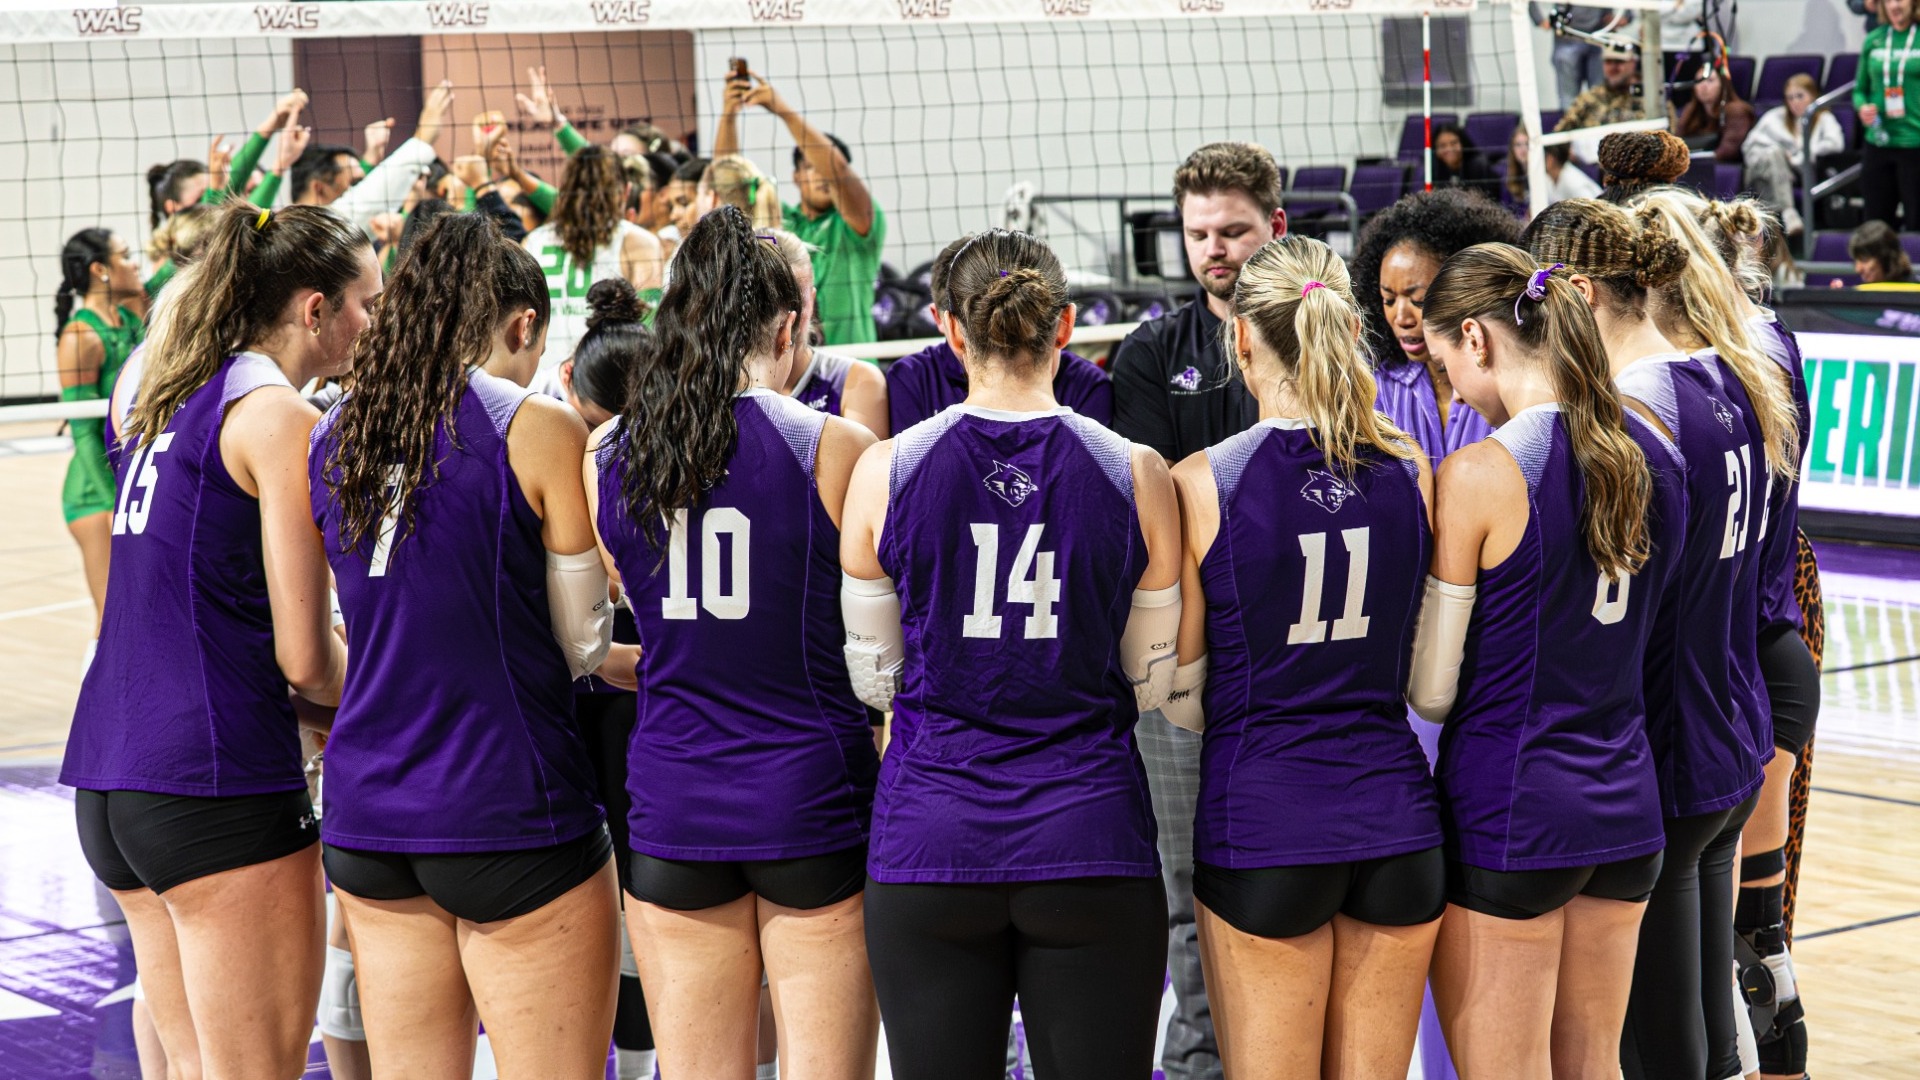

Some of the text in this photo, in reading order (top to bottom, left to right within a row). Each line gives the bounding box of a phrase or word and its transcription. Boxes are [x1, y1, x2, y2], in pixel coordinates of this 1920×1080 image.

[73, 7, 142, 34] WAC
[254, 5, 320, 31] WAC
[427, 2, 489, 26] WAC
[591, 0, 650, 24] WAC
[748, 0, 804, 21] WAC
[897, 0, 950, 19] WAC
[112, 432, 176, 535] 15
[1719, 443, 1751, 560] 21
[368, 462, 406, 577] 7
[659, 507, 750, 620] 10
[962, 522, 1061, 640] 14
[1286, 526, 1371, 645] 11
